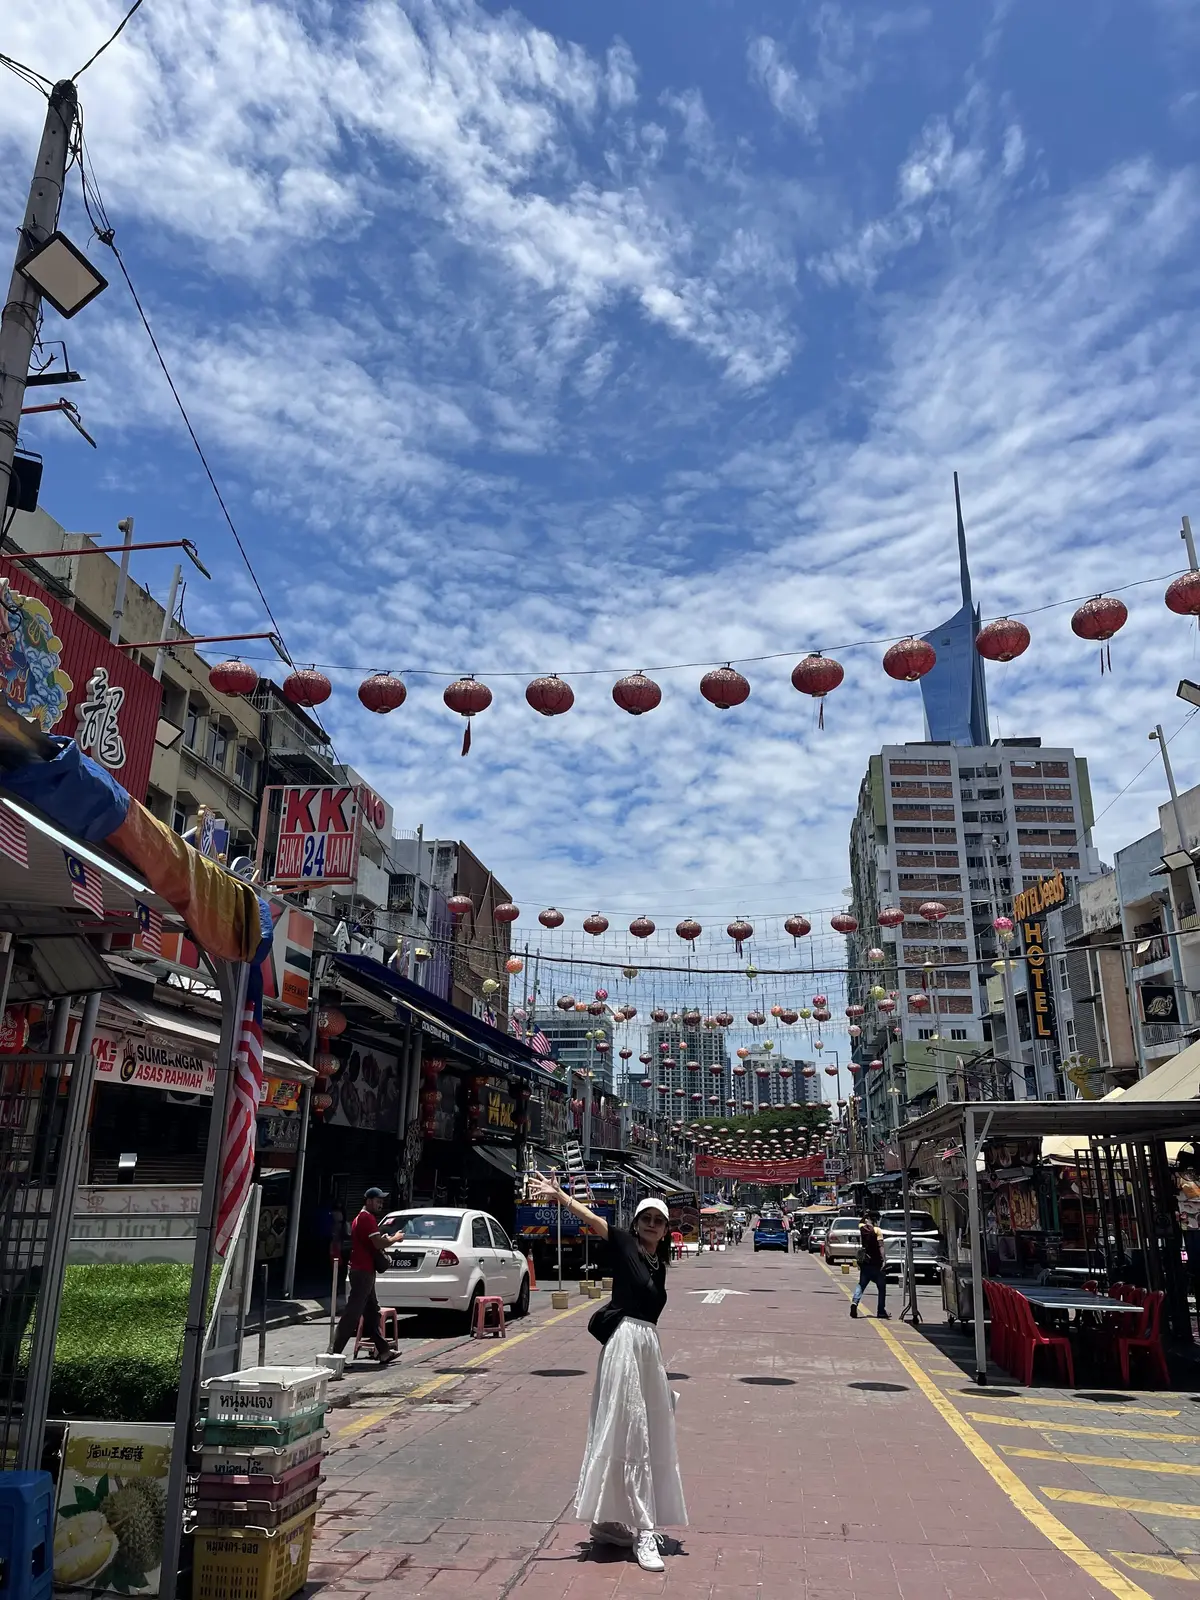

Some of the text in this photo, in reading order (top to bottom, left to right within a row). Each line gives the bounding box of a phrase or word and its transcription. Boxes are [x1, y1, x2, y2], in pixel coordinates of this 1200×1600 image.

[286, 788, 353, 833] KK
[278, 835, 351, 877] BUKA 24 JAM
[1014, 886, 1042, 922] HOTEL
[1024, 922, 1051, 1036] HOTEL
[135, 1064, 164, 1082] ASAS
[163, 1071, 203, 1089] RAHMAH
[137, 1044, 204, 1072] SUMBANGAN
